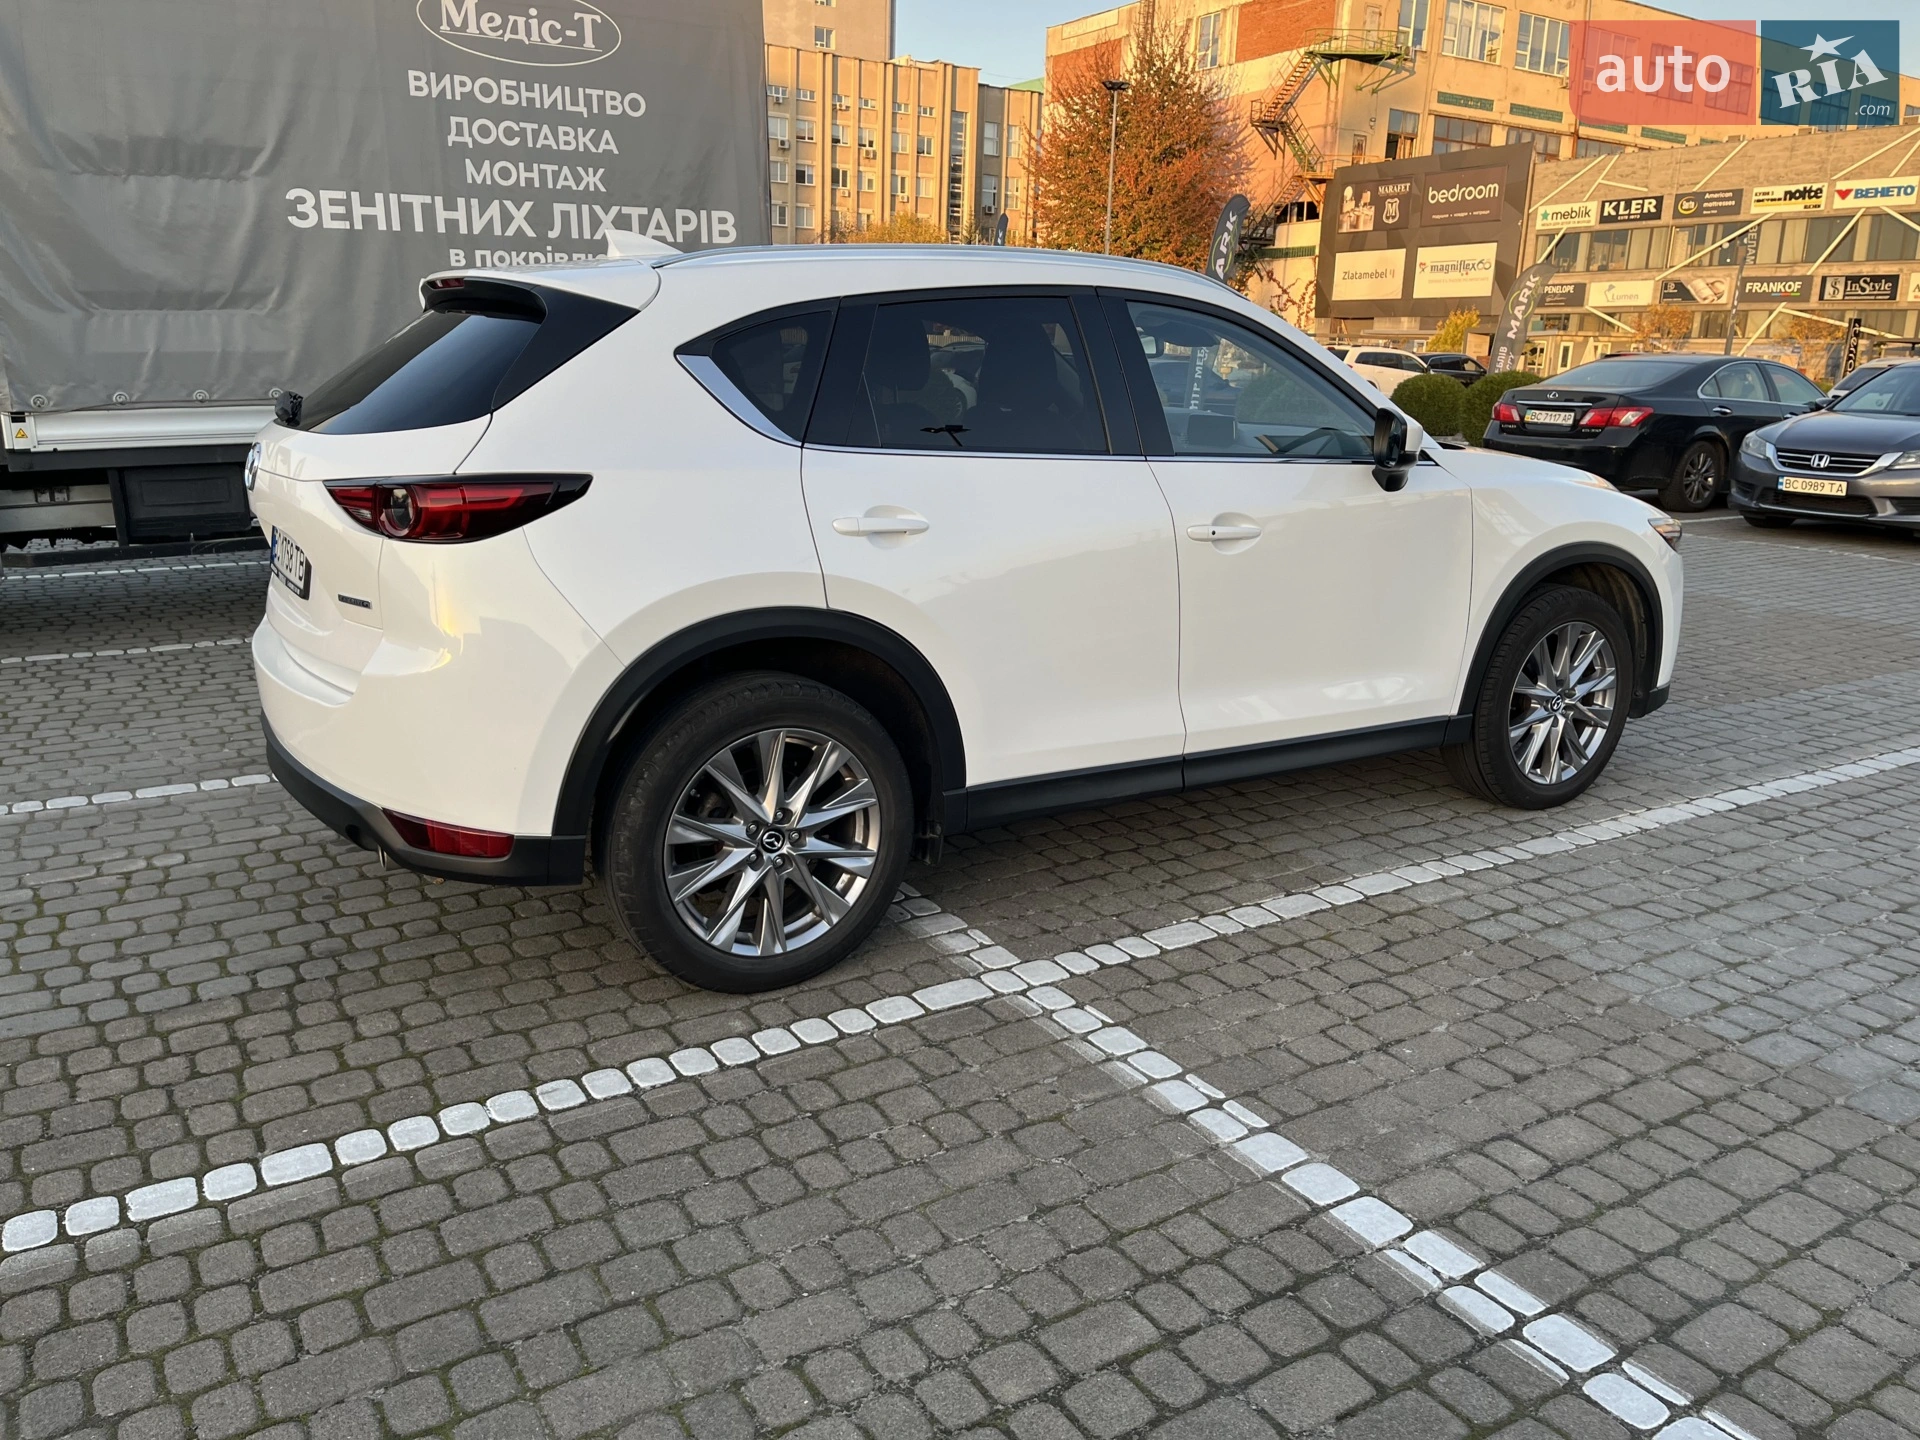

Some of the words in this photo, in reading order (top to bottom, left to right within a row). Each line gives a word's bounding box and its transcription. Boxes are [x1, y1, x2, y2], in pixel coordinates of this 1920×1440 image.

[440, 0, 601, 48] Медіс-Т
[407, 69, 646, 118] ВИРОБНИЦТВО
[447, 116, 619, 154] ДОСТАВКА
[465, 158, 606, 193] МОНТАЖ
[1378, 182, 1411, 194] MARAFET
[1428, 183, 1499, 204] bedroom
[1783, 185, 1823, 202] nolte
[285, 188, 537, 238] ЗЕНІТНИХ
[548, 203, 737, 244] ЛІХТАРІВ
[1551, 206, 1591, 221] meblik
[1603, 198, 1657, 217] KLER
[1215, 210, 1238, 280] ARK
[1342, 268, 1388, 280] Zlatamebel
[1430, 260, 1476, 274] magniflex
[1544, 284, 1575, 293] PENELOPE
[1745, 281, 1802, 293] FRANKOF
[1846, 277, 1892, 295] InStyle
[1611, 292, 1639, 301] Lumen
[1506, 274, 1540, 340] MARK
[1530, 411, 1543, 421] BC
[1543, 412, 1560, 421] 7117
[1562, 413, 1572, 422] AP
[1784, 478, 1799, 490] BC
[1801, 480, 1825, 492] 0989
[1828, 482, 1844, 494] TA
